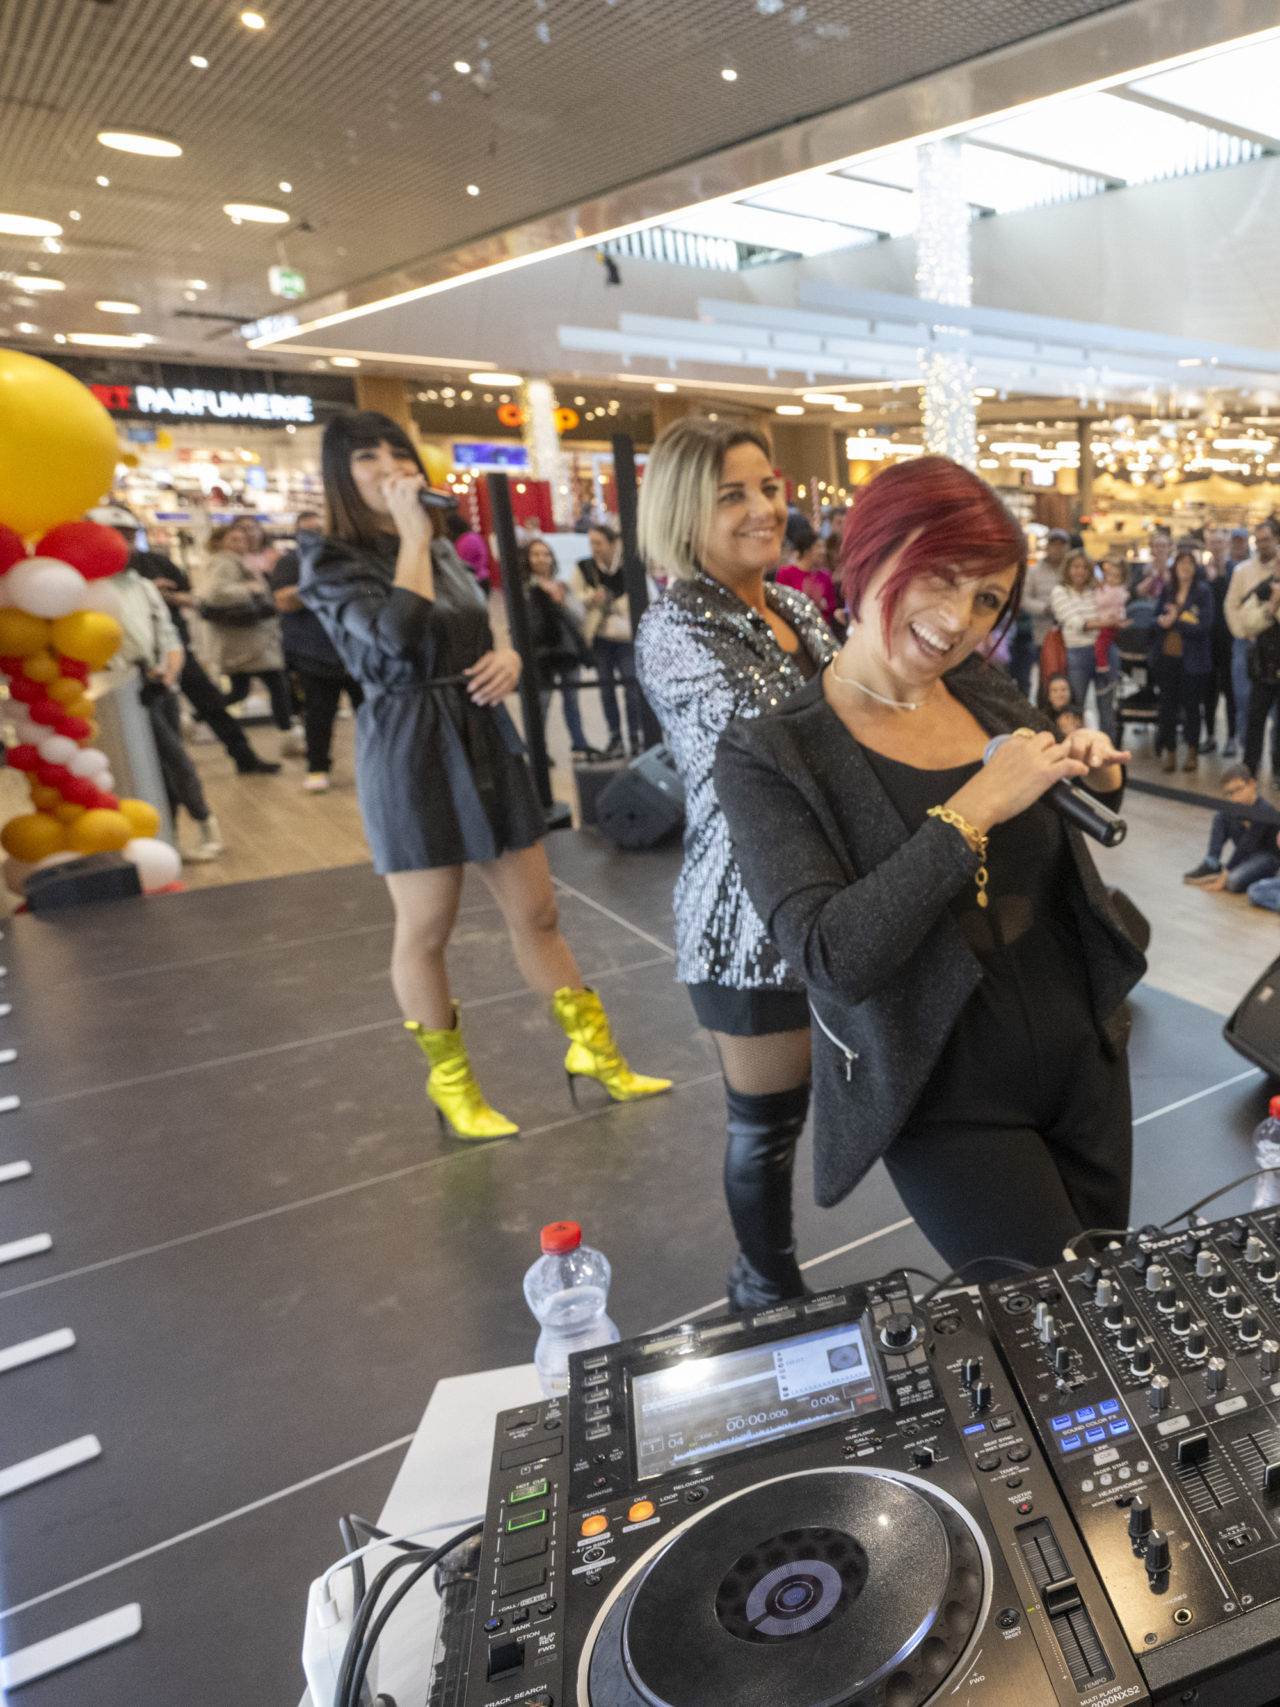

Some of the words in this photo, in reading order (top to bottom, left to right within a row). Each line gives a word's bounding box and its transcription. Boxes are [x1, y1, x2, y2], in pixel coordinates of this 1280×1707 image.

[135, 385, 314, 421] PARFUMERIE
[668, 1437, 684, 1449] 04
[1098, 1478, 1144, 1498] HEADPHONES
[660, 1493, 678, 1502] LOOP
[509, 1622, 531, 1634] BANK
[1002, 1626, 1021, 1637] TEMPO
[538, 1632, 556, 1642] SLIP
[539, 1637, 555, 1647] REV
[537, 1644, 556, 1654] FWD
[969, 1675, 986, 1686] FWD
[1083, 1677, 1107, 1690] TEMPO
[483, 1696, 512, 1707] TRACK
[514, 1684, 547, 1700] SEARCH
[1080, 1695, 1099, 1706] MULTI
[1098, 1685, 1122, 1699] PLAYER
